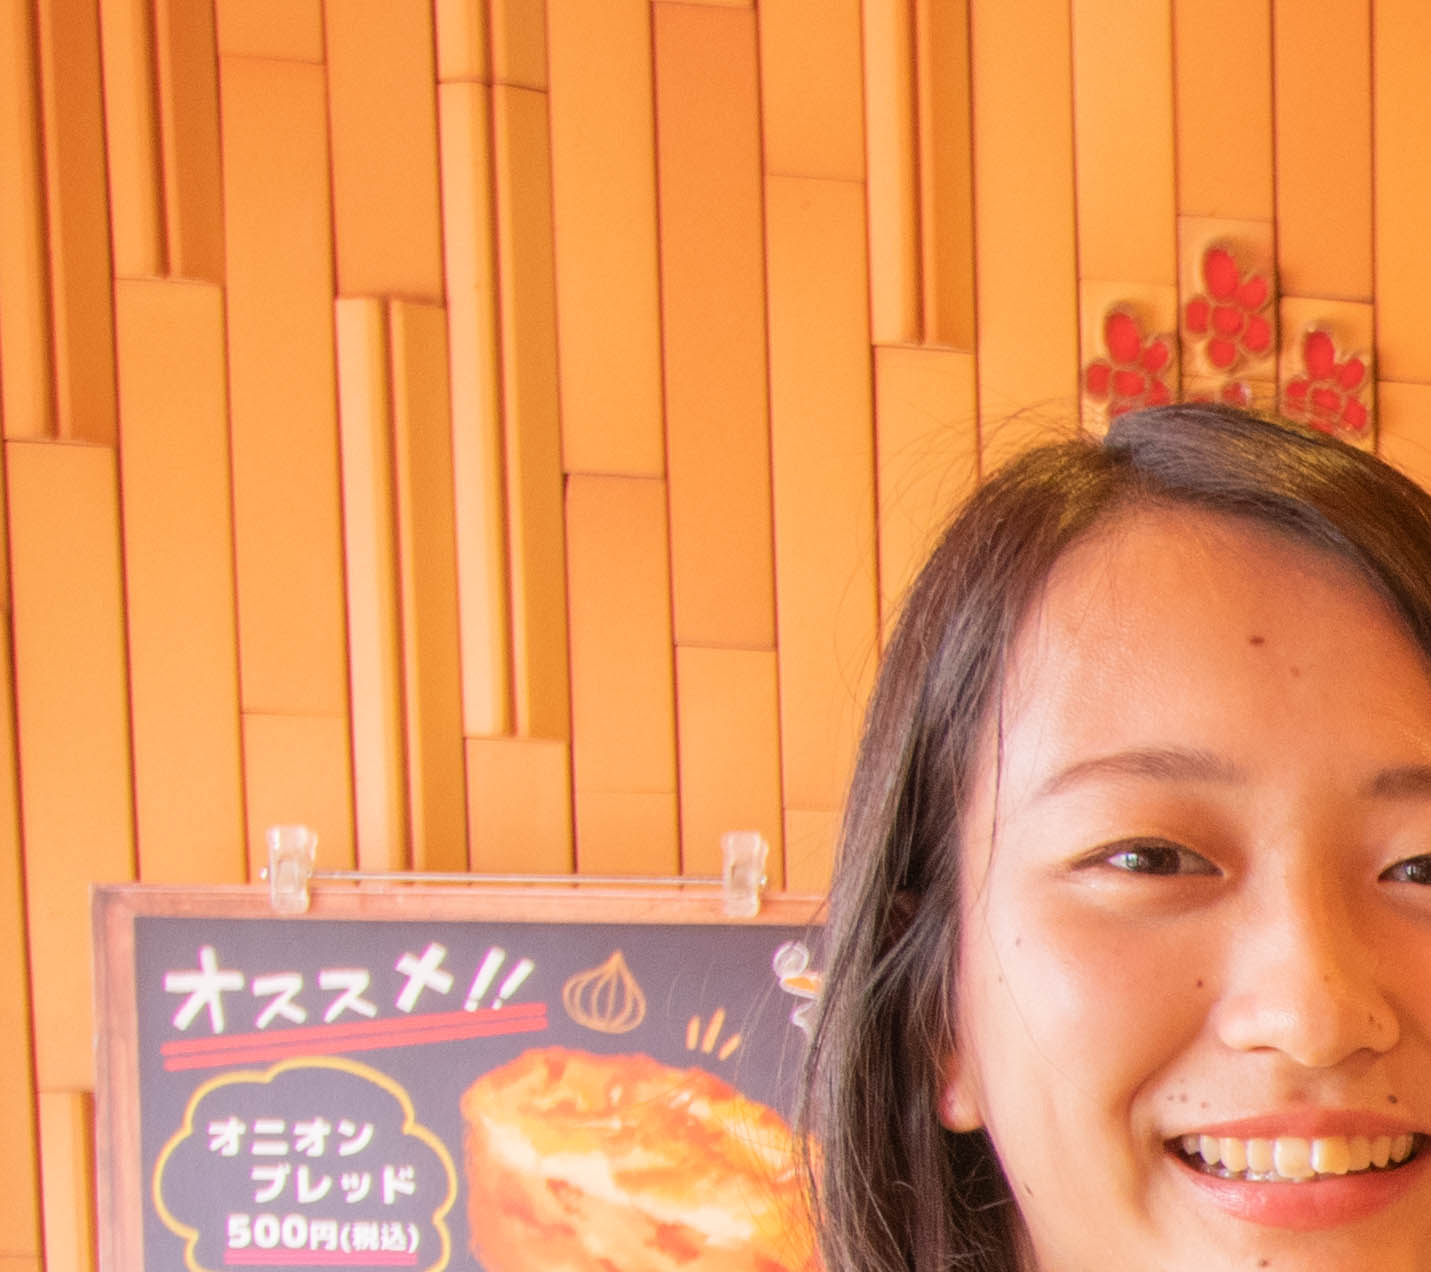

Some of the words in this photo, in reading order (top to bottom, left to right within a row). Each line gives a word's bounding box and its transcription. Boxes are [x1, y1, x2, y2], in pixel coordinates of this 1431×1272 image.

[208, 1118, 374, 1160] オニオン
[250, 1165, 417, 1206] ブレッド
[227, 1214, 421, 1256] 500円(税込)
